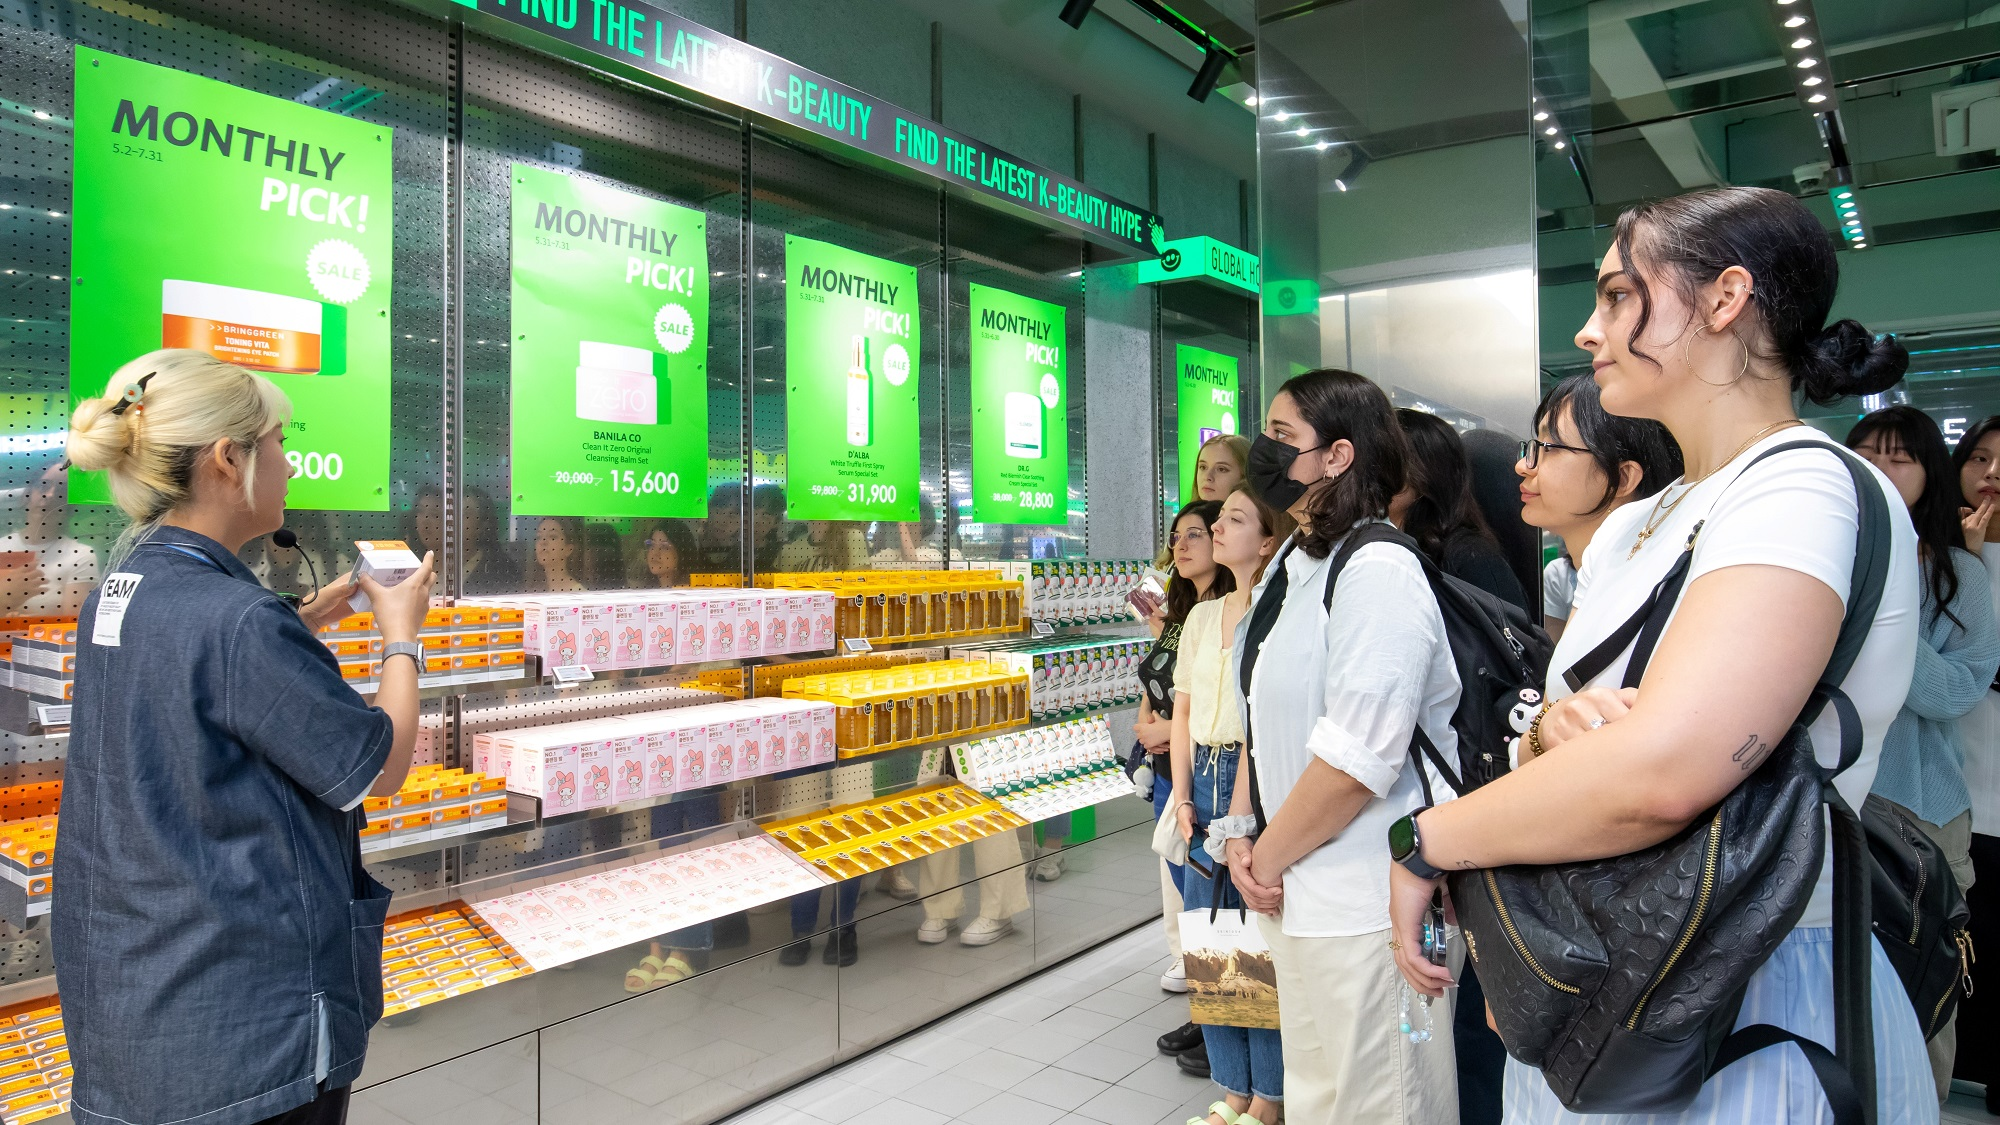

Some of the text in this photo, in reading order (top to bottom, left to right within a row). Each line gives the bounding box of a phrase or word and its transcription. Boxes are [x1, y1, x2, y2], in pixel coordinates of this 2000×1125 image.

[498, 0, 872, 141] ND THE LATEST K-BEAUTY
[111, 98, 346, 181] MONTHLY
[112, 142, 164, 163] 5.2-7.31
[895, 117, 1142, 243] FIND THE LATEST K-BEAUTY HYPE
[259, 176, 370, 234] PICK!
[534, 201, 678, 257] MONTHLY
[535, 236, 570, 250] 5.31-7.31
[316, 261, 363, 281] SALE
[1211, 246, 1247, 282] GLOBAL
[625, 256, 695, 297] PICK!
[800, 264, 899, 306] MONTHLY
[799, 292, 825, 304] 5.31-7.31
[660, 321, 690, 336] SALE
[863, 306, 910, 339] PICK!
[981, 308, 1051, 341] MONTHLY
[224, 336, 270, 350] TONING VITA
[887, 359, 907, 371] SALE
[1026, 341, 1059, 369] PICK!
[1184, 363, 1228, 386] MONTHLY
[1043, 386, 1057, 396] SALE
[1211, 388, 1234, 408] PICK!
[593, 430, 642, 443] BANILA CO
[582, 442, 652, 455] Clean It Zero Original
[585, 453, 649, 465] Cleansing Balm Set
[848, 450, 870, 460] D'ALBA
[830, 459, 846, 467] White
[555, 469, 680, 497] 20,000 15,600
[811, 483, 897, 506] 59,800 31,900
[1019, 490, 1054, 511] 28,800
[103, 579, 136, 598] TEAM
